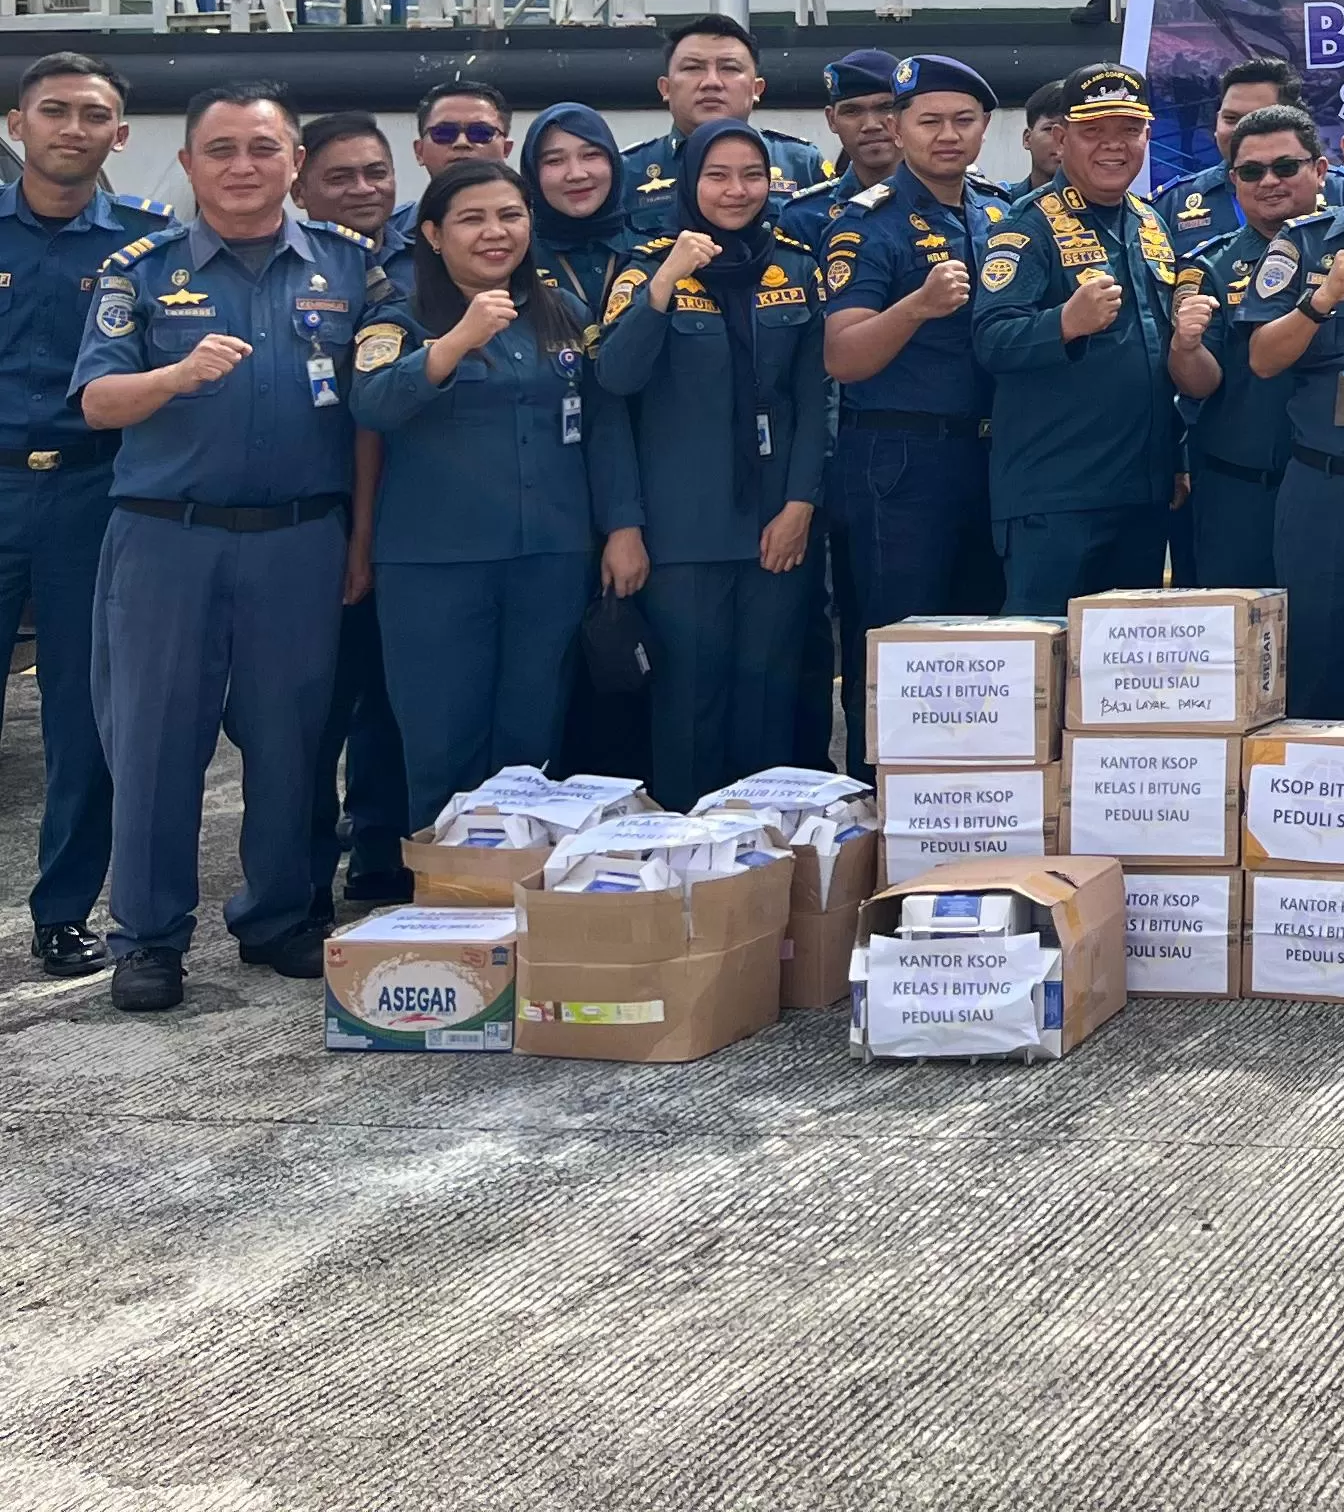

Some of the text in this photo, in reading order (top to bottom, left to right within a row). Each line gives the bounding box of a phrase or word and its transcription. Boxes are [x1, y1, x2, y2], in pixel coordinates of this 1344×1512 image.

[758, 289, 799, 305] KPLP
[1108, 625, 1206, 638] KANTOR KSOP
[1103, 650, 1210, 664] KELAS I BITUNG
[1263, 631, 1271, 691] ASEGAR
[906, 659, 1006, 673] KANTOR KSOP
[1114, 676, 1200, 689] PEDULI SIAU
[901, 684, 1010, 698] KELAS I BITUNG
[1136, 699, 1170, 711] LAYAK
[1178, 698, 1212, 709] PAKAI
[912, 711, 999, 724] PEDULI SIAU
[1100, 756, 1198, 770] KANTOR KSOP
[1094, 781, 1202, 795] KELAS I BITUNG
[1269, 777, 1315, 797] KSOP
[913, 791, 1014, 805] KANTOR KSOP
[1104, 808, 1190, 821] PEDULI SIAU
[1272, 808, 1332, 828] PEDULI
[909, 816, 1018, 829] KELAS I BITUNG
[920, 841, 1007, 854] PEDULI SIAU
[1126, 893, 1200, 908] NTOR KSOP
[1280, 898, 1337, 914] KANTOR
[1150, 919, 1203, 934] BITUNG
[1274, 922, 1314, 937] KELAS
[1125, 944, 1192, 959] DULI SIAU
[1286, 948, 1334, 964] PEDULI
[899, 955, 1007, 970] KANTOR KSOP
[893, 981, 1012, 995] KELAS I BITUNG
[378, 986, 457, 1012] ASEGAR
[902, 1009, 994, 1025] PEDULI SIAU
